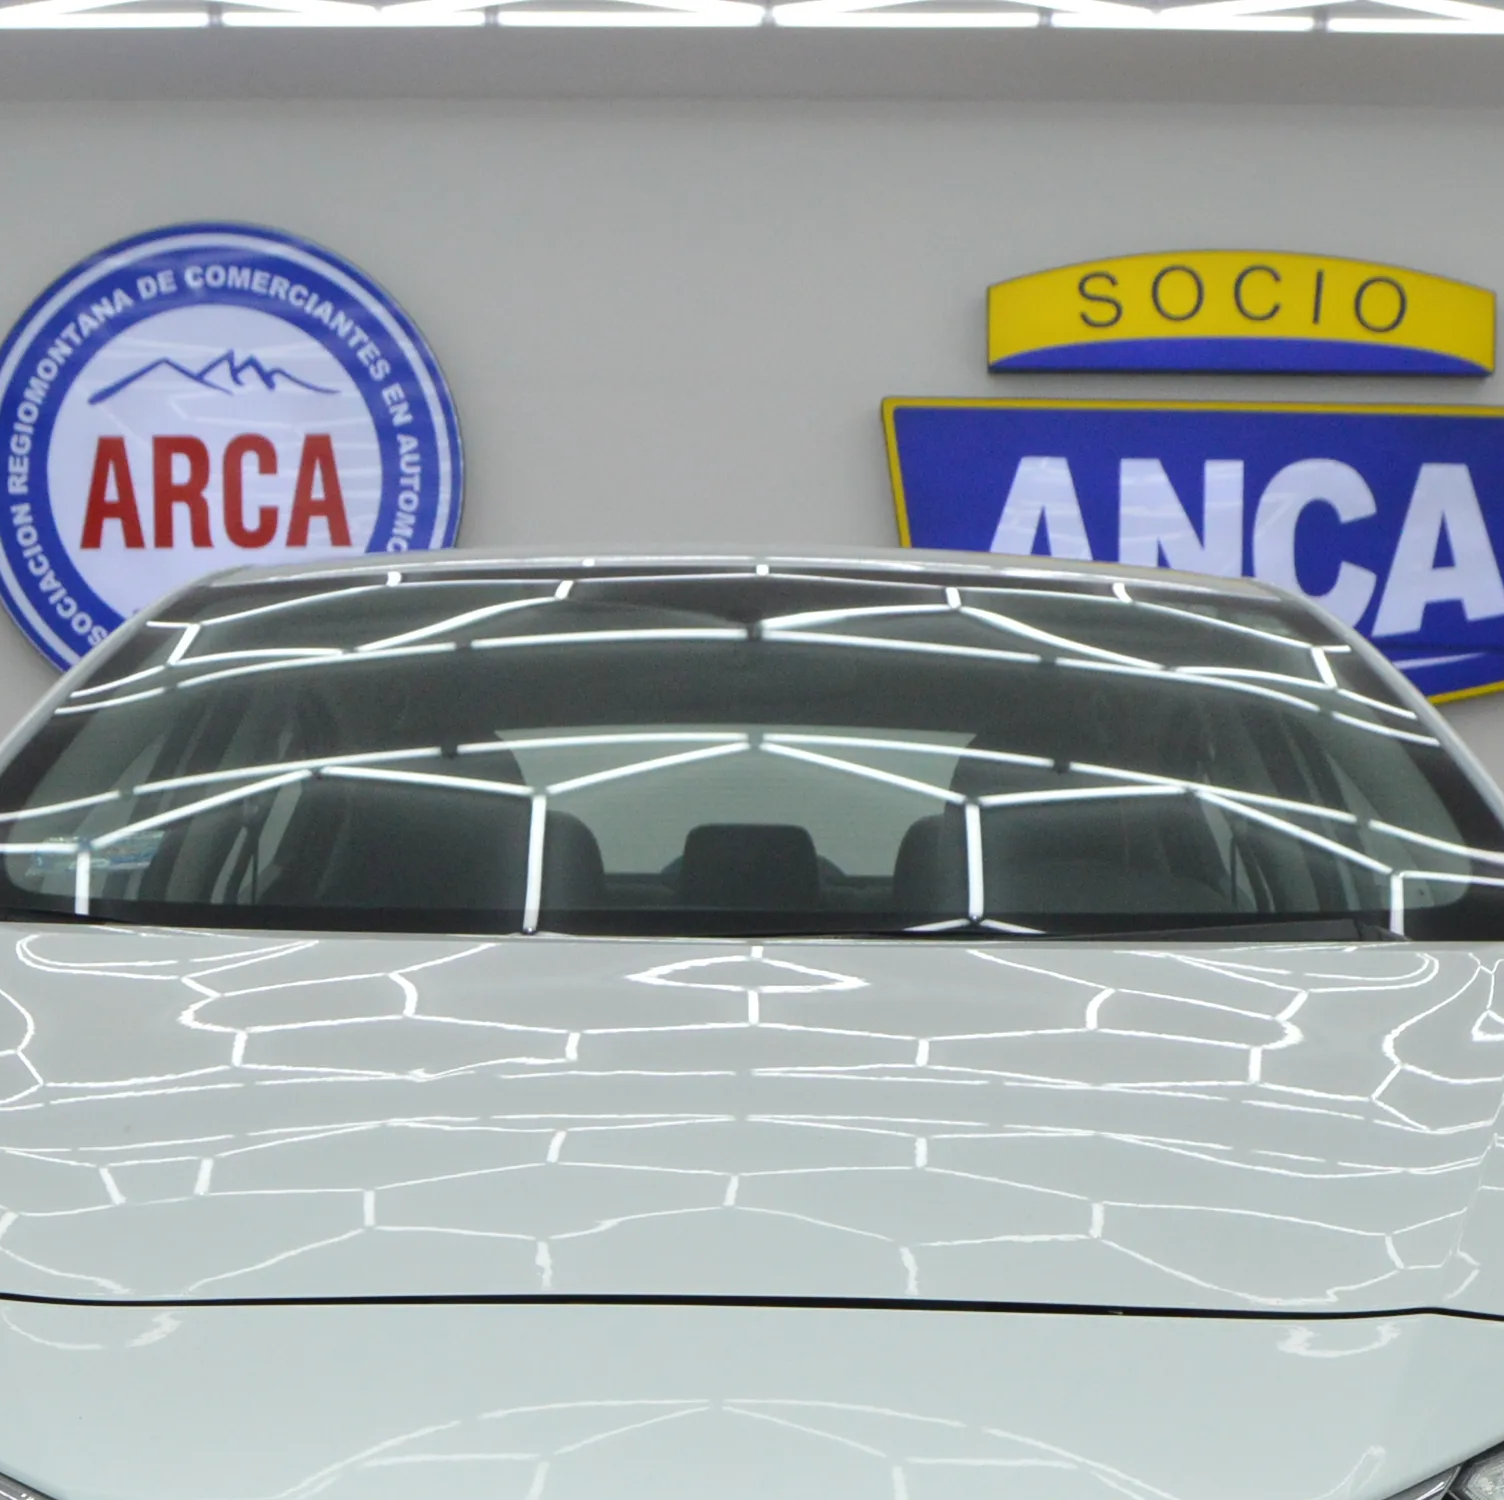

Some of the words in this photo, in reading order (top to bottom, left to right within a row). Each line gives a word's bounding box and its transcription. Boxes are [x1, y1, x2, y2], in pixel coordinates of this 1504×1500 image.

[1077, 265, 1408, 333] SOCIO
[7, 287, 134, 496] REGIOMONTANA
[136, 268, 178, 302] DE
[184, 264, 391, 382] COMERCIANTES
[381, 382, 414, 427] EN
[79, 432, 353, 550] ARCA
